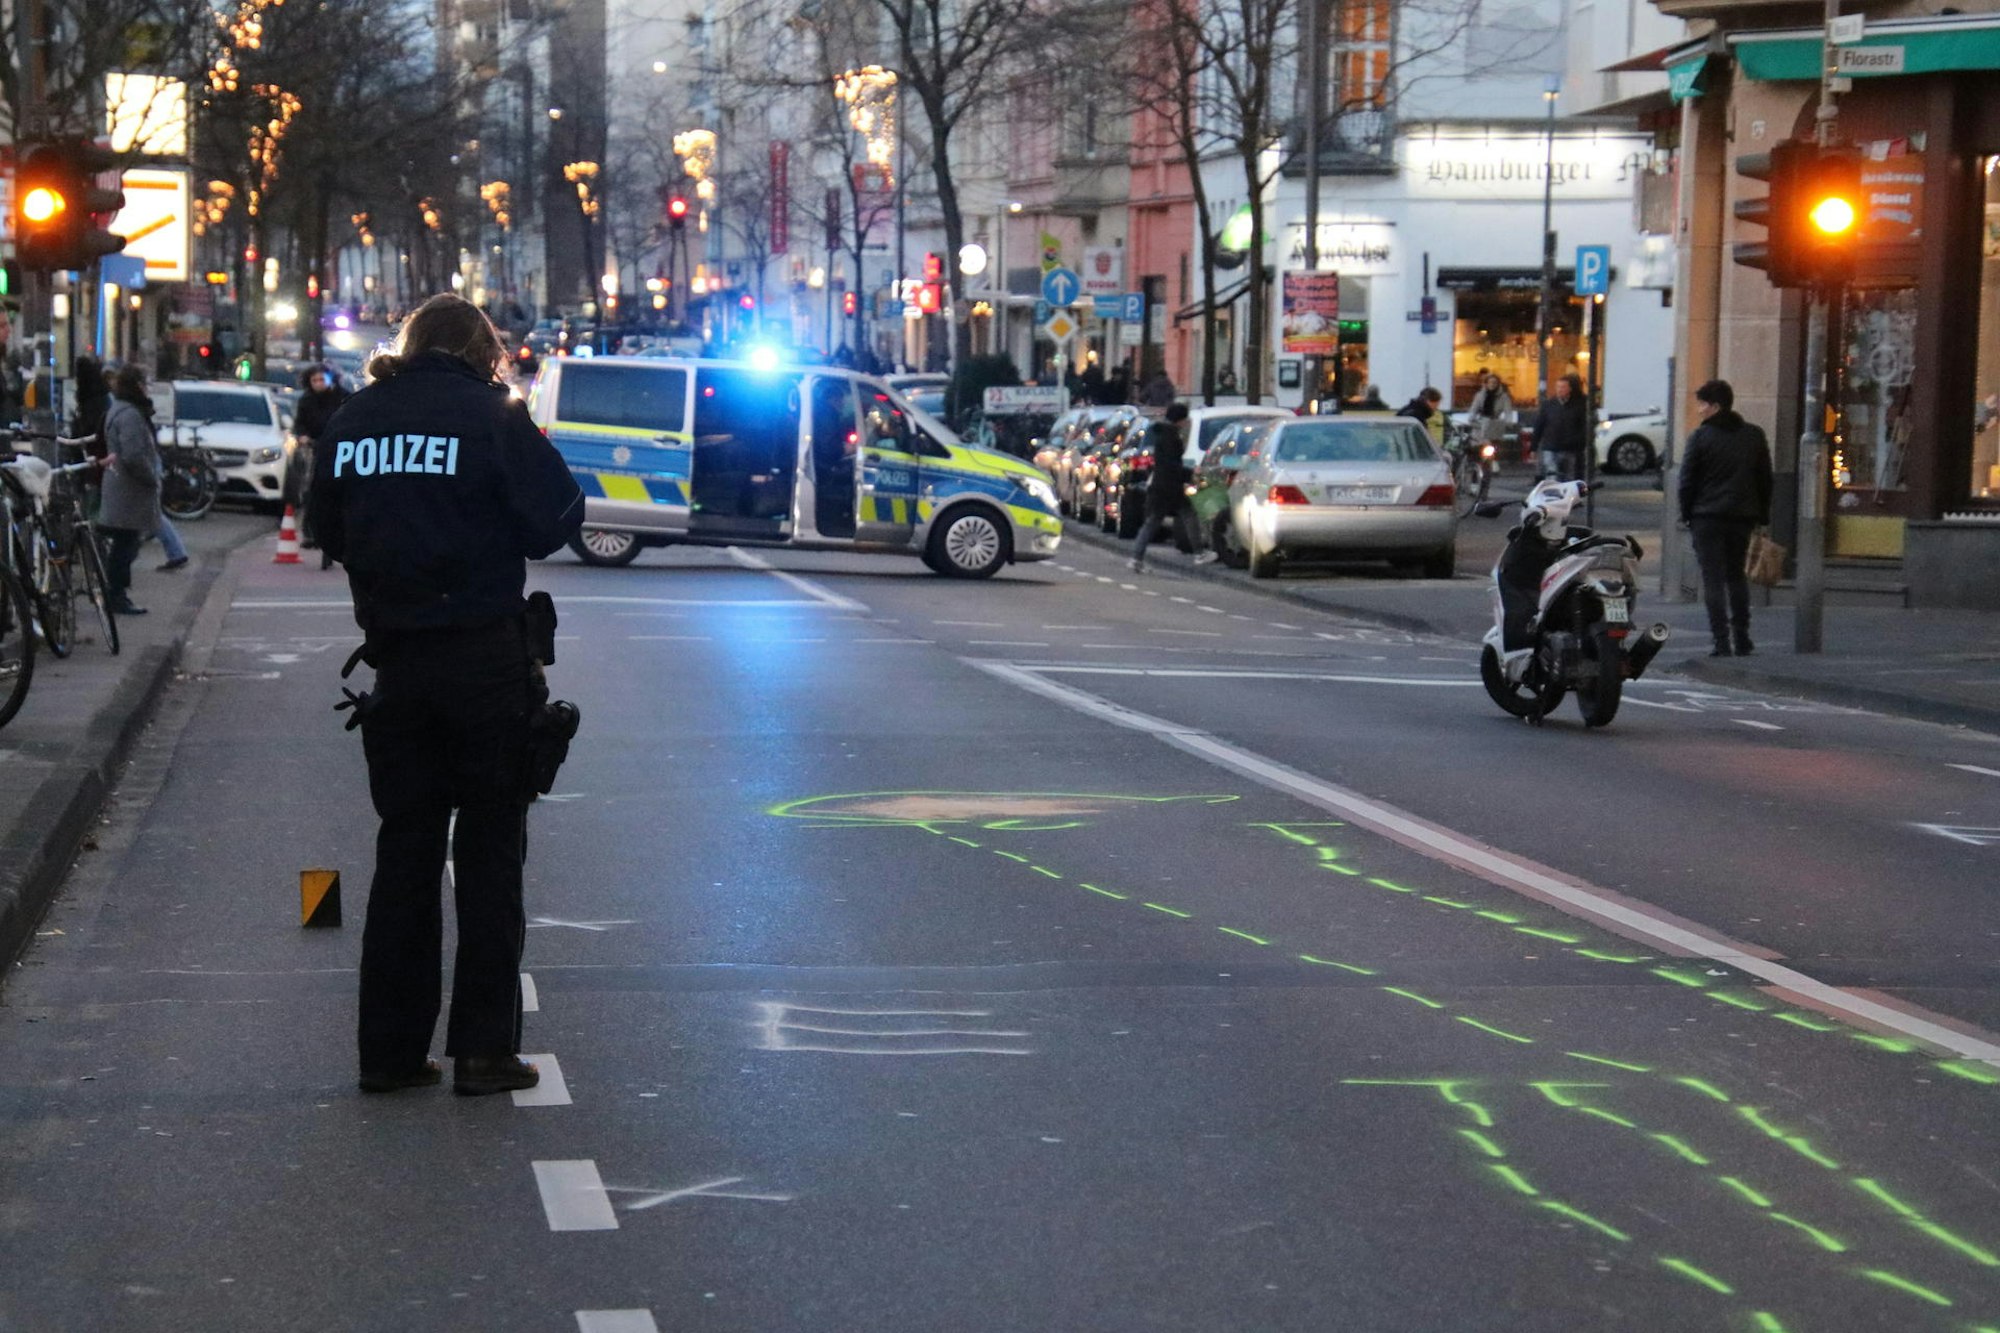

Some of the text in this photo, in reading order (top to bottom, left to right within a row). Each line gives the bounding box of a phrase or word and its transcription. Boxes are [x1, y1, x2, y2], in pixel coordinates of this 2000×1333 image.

[1844, 50, 1899, 67] Florastr.
[1426, 156, 1593, 186] Hamburger
[1581, 251, 1601, 288] P
[334, 434, 459, 478] POLIZEI
